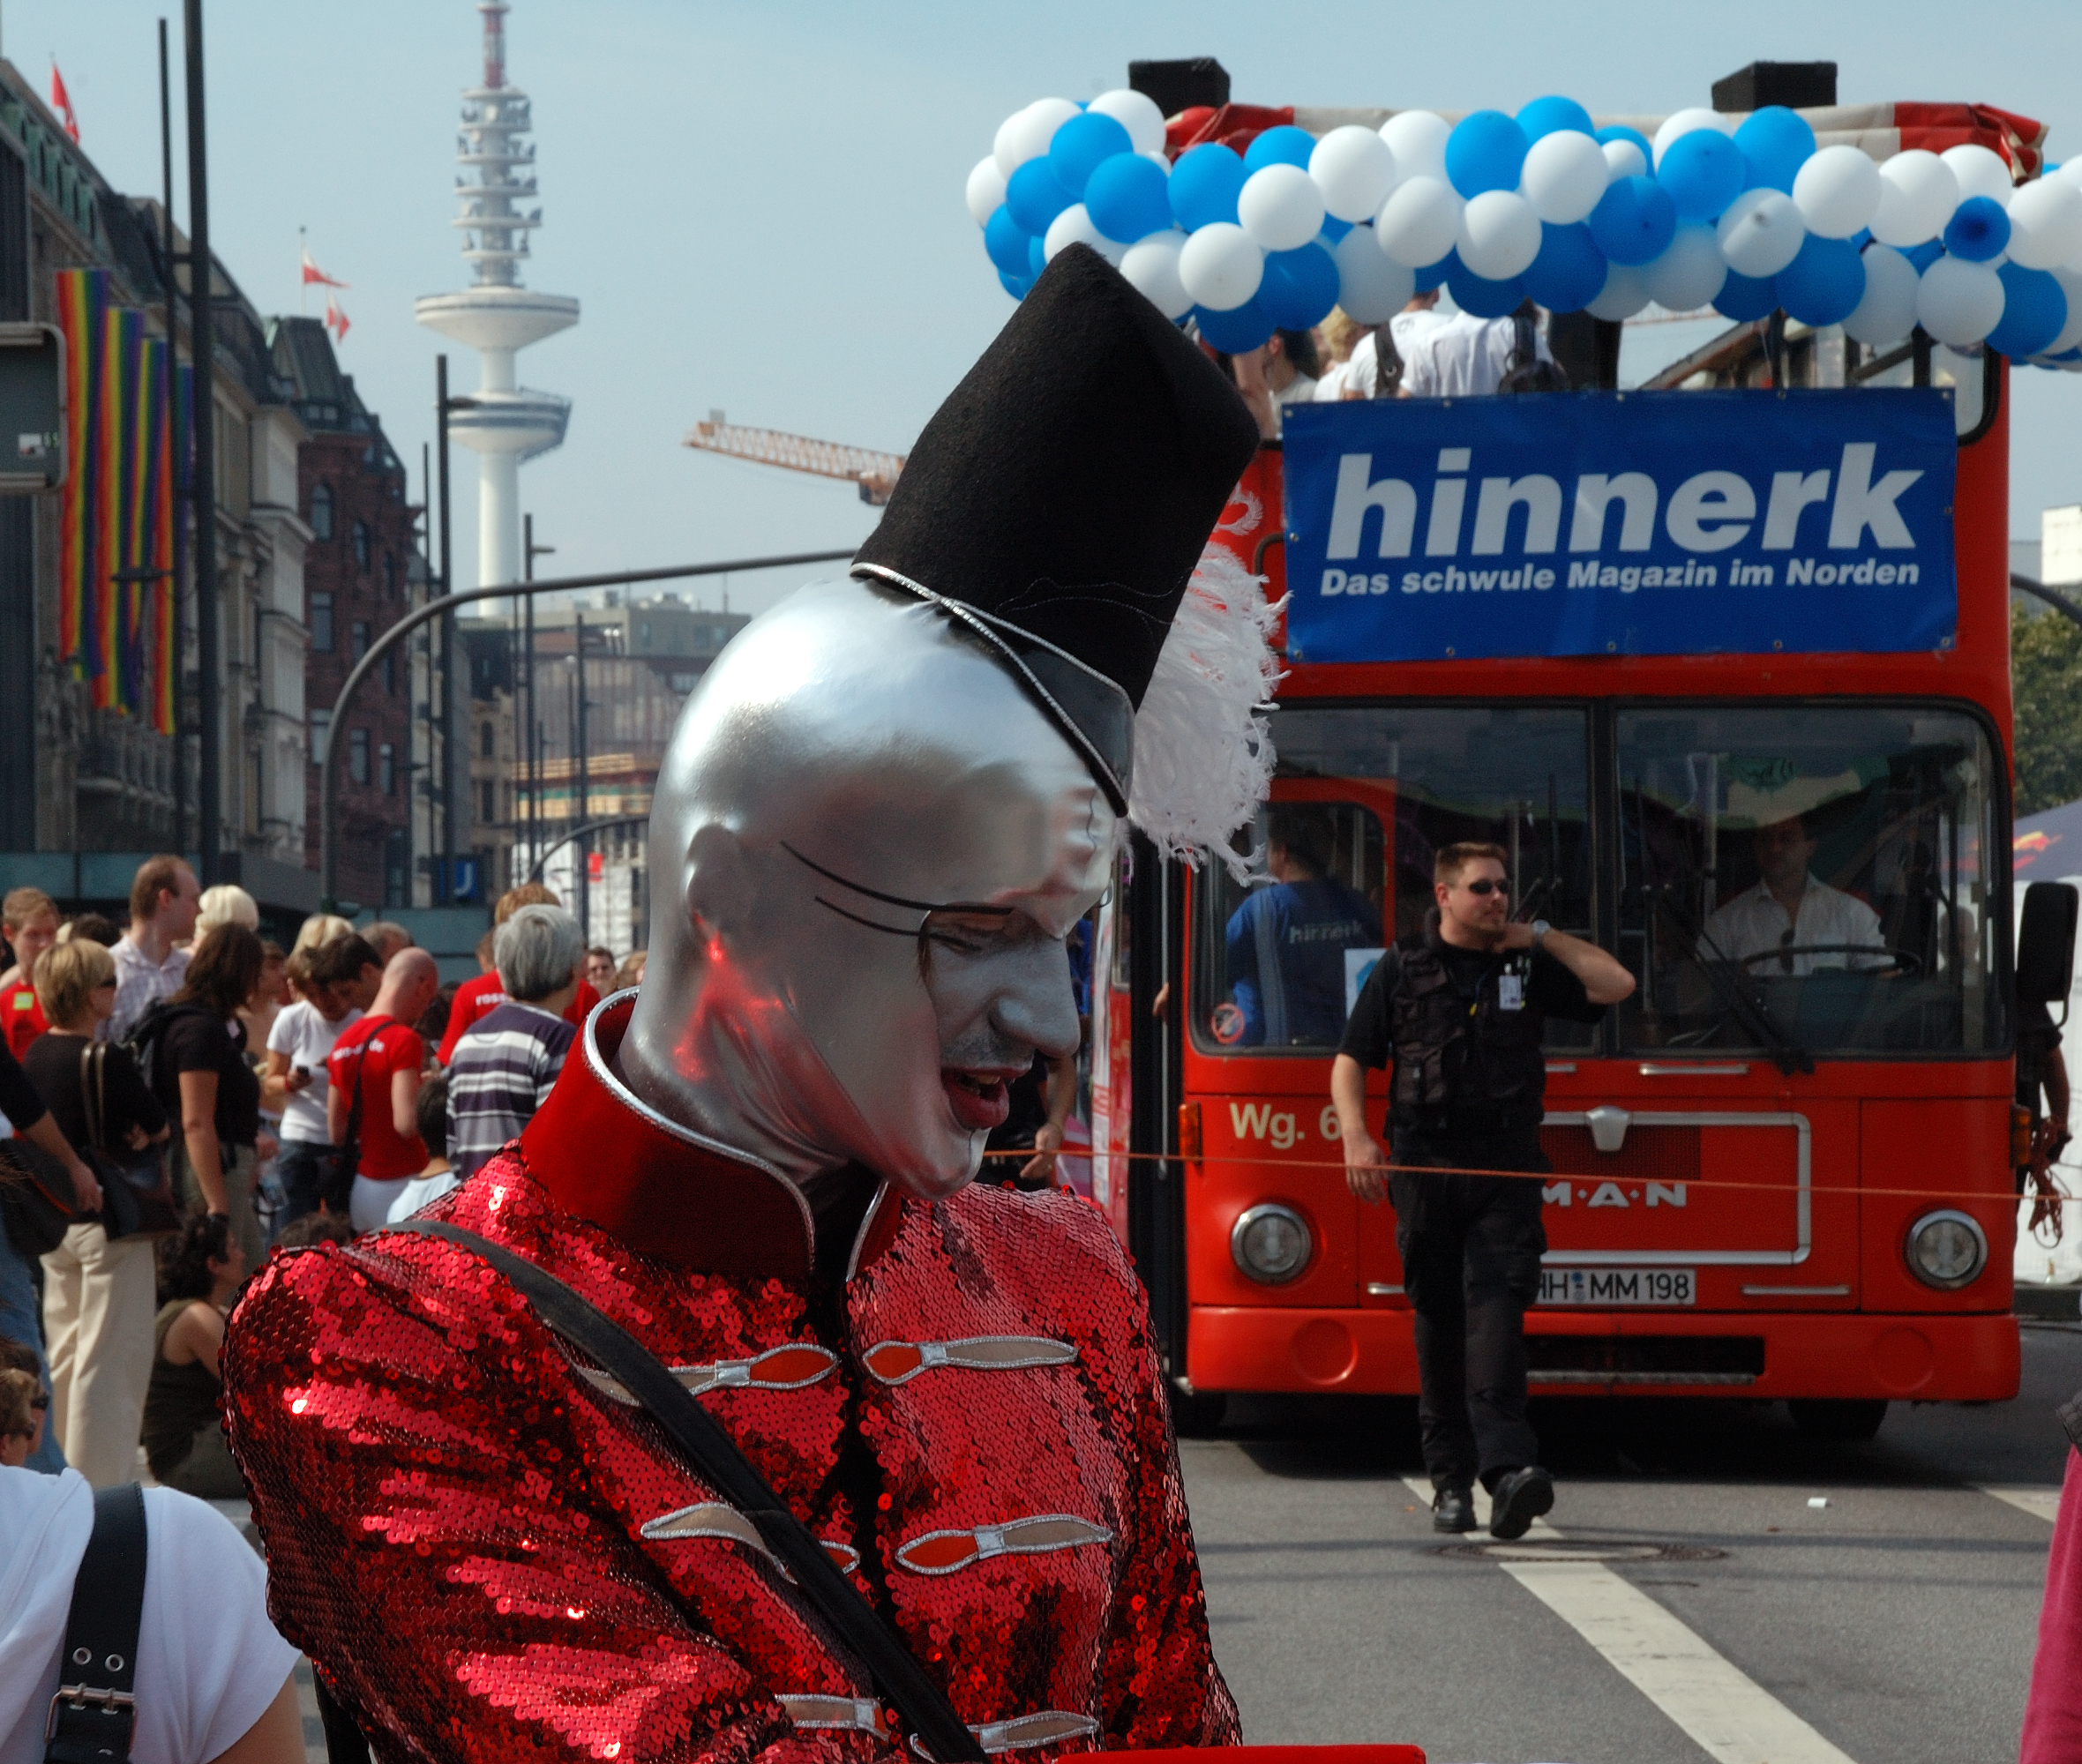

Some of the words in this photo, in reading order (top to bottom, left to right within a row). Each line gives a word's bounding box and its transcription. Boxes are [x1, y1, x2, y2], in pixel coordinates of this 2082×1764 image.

[1325, 442, 1925, 559] hinnerk
[1320, 568, 1389, 596] Das
[1401, 563, 1555, 594] schwule
[1567, 558, 1718, 594] Magazin
[1729, 557, 1774, 587] im
[1786, 557, 1920, 586] Norden
[1229, 1102, 1305, 1149] Wg.
[1646, 1273, 1689, 1300] 198
